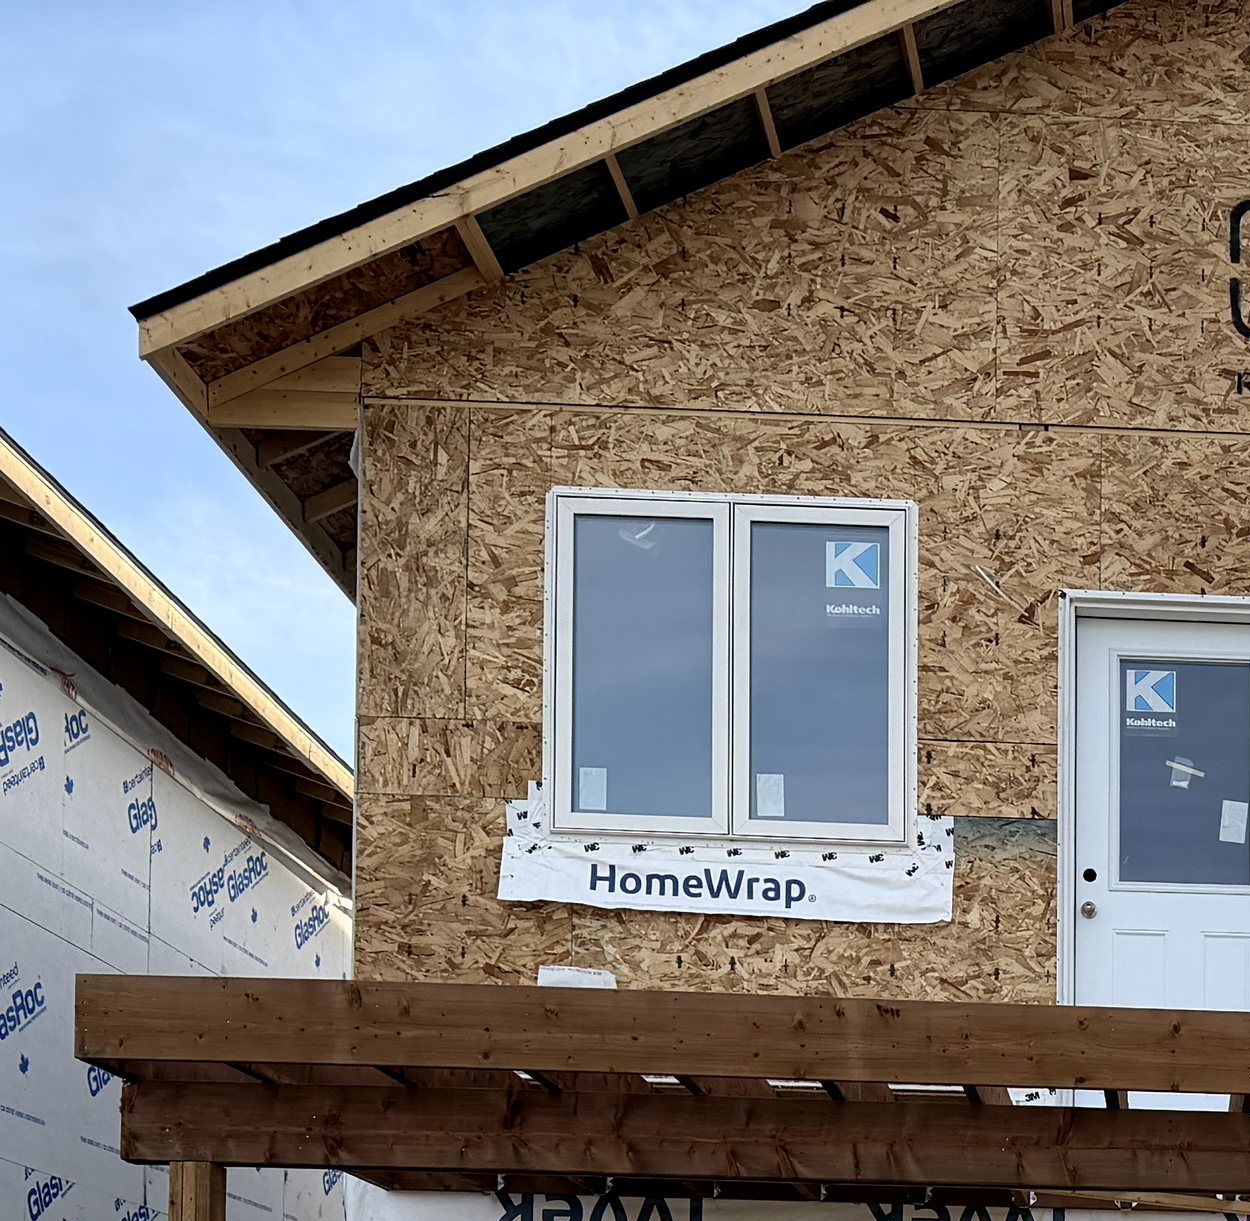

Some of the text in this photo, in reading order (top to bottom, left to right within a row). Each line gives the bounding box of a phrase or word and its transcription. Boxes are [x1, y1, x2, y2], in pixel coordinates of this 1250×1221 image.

[826, 604, 880, 615] Kohltech
[1126, 718, 1176, 727] Kohltech
[584, 843, 884, 863] 3M 3M 3M 3M 3M 3M 3M
[227, 850, 268, 902] GlasRoc
[294, 901, 330, 950] GlasRoc
[1025, 1091, 1040, 1102] 3M
